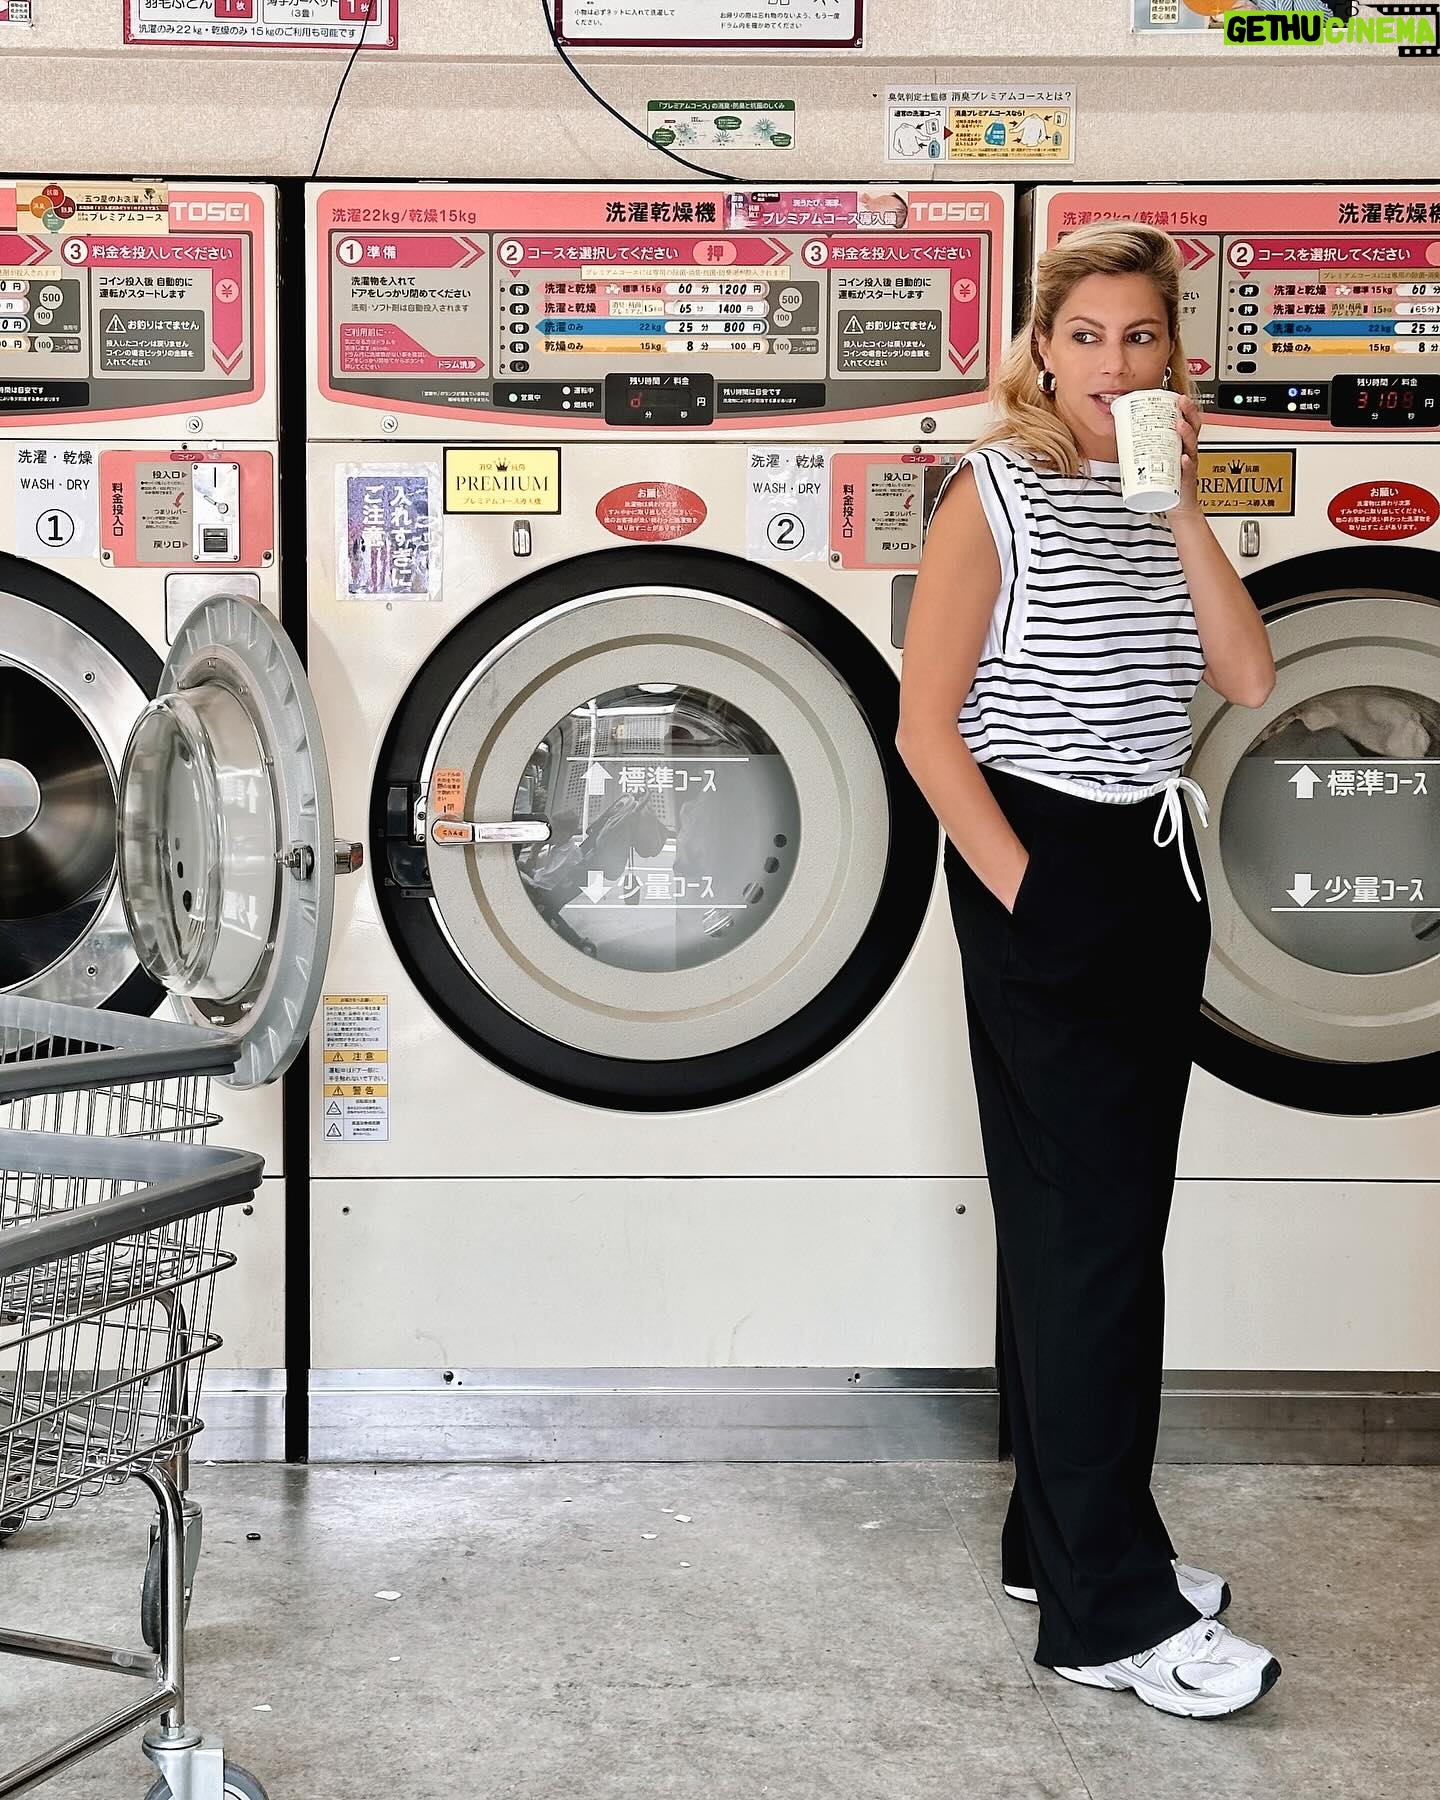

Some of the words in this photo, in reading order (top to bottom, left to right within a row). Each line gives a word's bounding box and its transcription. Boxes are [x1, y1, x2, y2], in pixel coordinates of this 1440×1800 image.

[89, 213, 163, 222] プレミアムコース
[169, 202, 249, 222] TOSEI
[605, 202, 716, 223] 洗濯乾燥機
[910, 203, 989, 222] TOSEI
[763, 212, 897, 225] プレミアムコース導入機
[92, 245, 233, 261] 料金を投入してください
[367, 246, 396, 259] 準備
[527, 246, 679, 261] コースを選択してください
[707, 246, 723, 262] 押
[831, 246, 972, 261] 料金を投入してください
[1258, 247, 1411, 261] コースを選択してください
[351, 276, 416, 286] 洗濯物を入れて
[99, 289, 186, 299] 運転がスタートします
[544, 283, 597, 294] 洗濯と乾燥
[678, 284, 693, 294] 60
[701, 284, 710, 293] 分
[719, 284, 748, 295] 1200
[753, 285, 762, 294] 円
[1273, 285, 1327, 296] 洗濯と乾燥
[1371, 286, 1393, 295] 15kg
[1412, 285, 1426, 295] 60
[42, 293, 61, 302] 500
[782, 295, 800, 304] 500
[838, 290, 924, 299] 運転がスタートします
[544, 302, 597, 313] 洗濯と乾燥
[679, 304, 692, 314] 65
[718, 304, 742, 314] 1400
[1272, 304, 1326, 315] 洗濯と乾燥
[37, 312, 50, 320] 100
[777, 313, 790, 321] 100
[127, 321, 200, 331] お釣りはでません
[544, 322, 584, 333] 洗濯のみ
[678, 322, 693, 332] 25
[701, 323, 709, 331] 分
[724, 322, 745, 333] 800
[753, 323, 761, 331] 円
[865, 321, 937, 331] お釣りはでません
[1411, 323, 1426, 334] 25
[38, 340, 51, 349] 100
[544, 341, 584, 352] 乾燥のみ
[686, 341, 694, 351] 8
[701, 342, 709, 351] 分
[731, 342, 746, 350] 100
[752, 343, 761, 351] 円
[776, 343, 790, 351] 100
[1272, 342, 1312, 353] 乾燥のみ
[1369, 344, 1391, 352] 15kg
[1418, 342, 1426, 352] 8
[696, 396, 707, 407] 円
[1424, 398, 1435, 408] 円
[152, 470, 181, 479] 投入口
[884, 473, 911, 481] 投入口
[456, 476, 549, 492] PREMIUM
[1370, 488, 1399, 497] お願い
[111, 483, 124, 537] 料金投入口
[842, 485, 854, 539] 料金投入口
[153, 540, 181, 549] 戻り口
[882, 542, 909, 550] 戻り口
[618, 766, 718, 794] 標準コース
[1327, 769, 1428, 797] 標準コース
[617, 873, 715, 900] 少量コース
[1324, 875, 1424, 903] 少量コース
